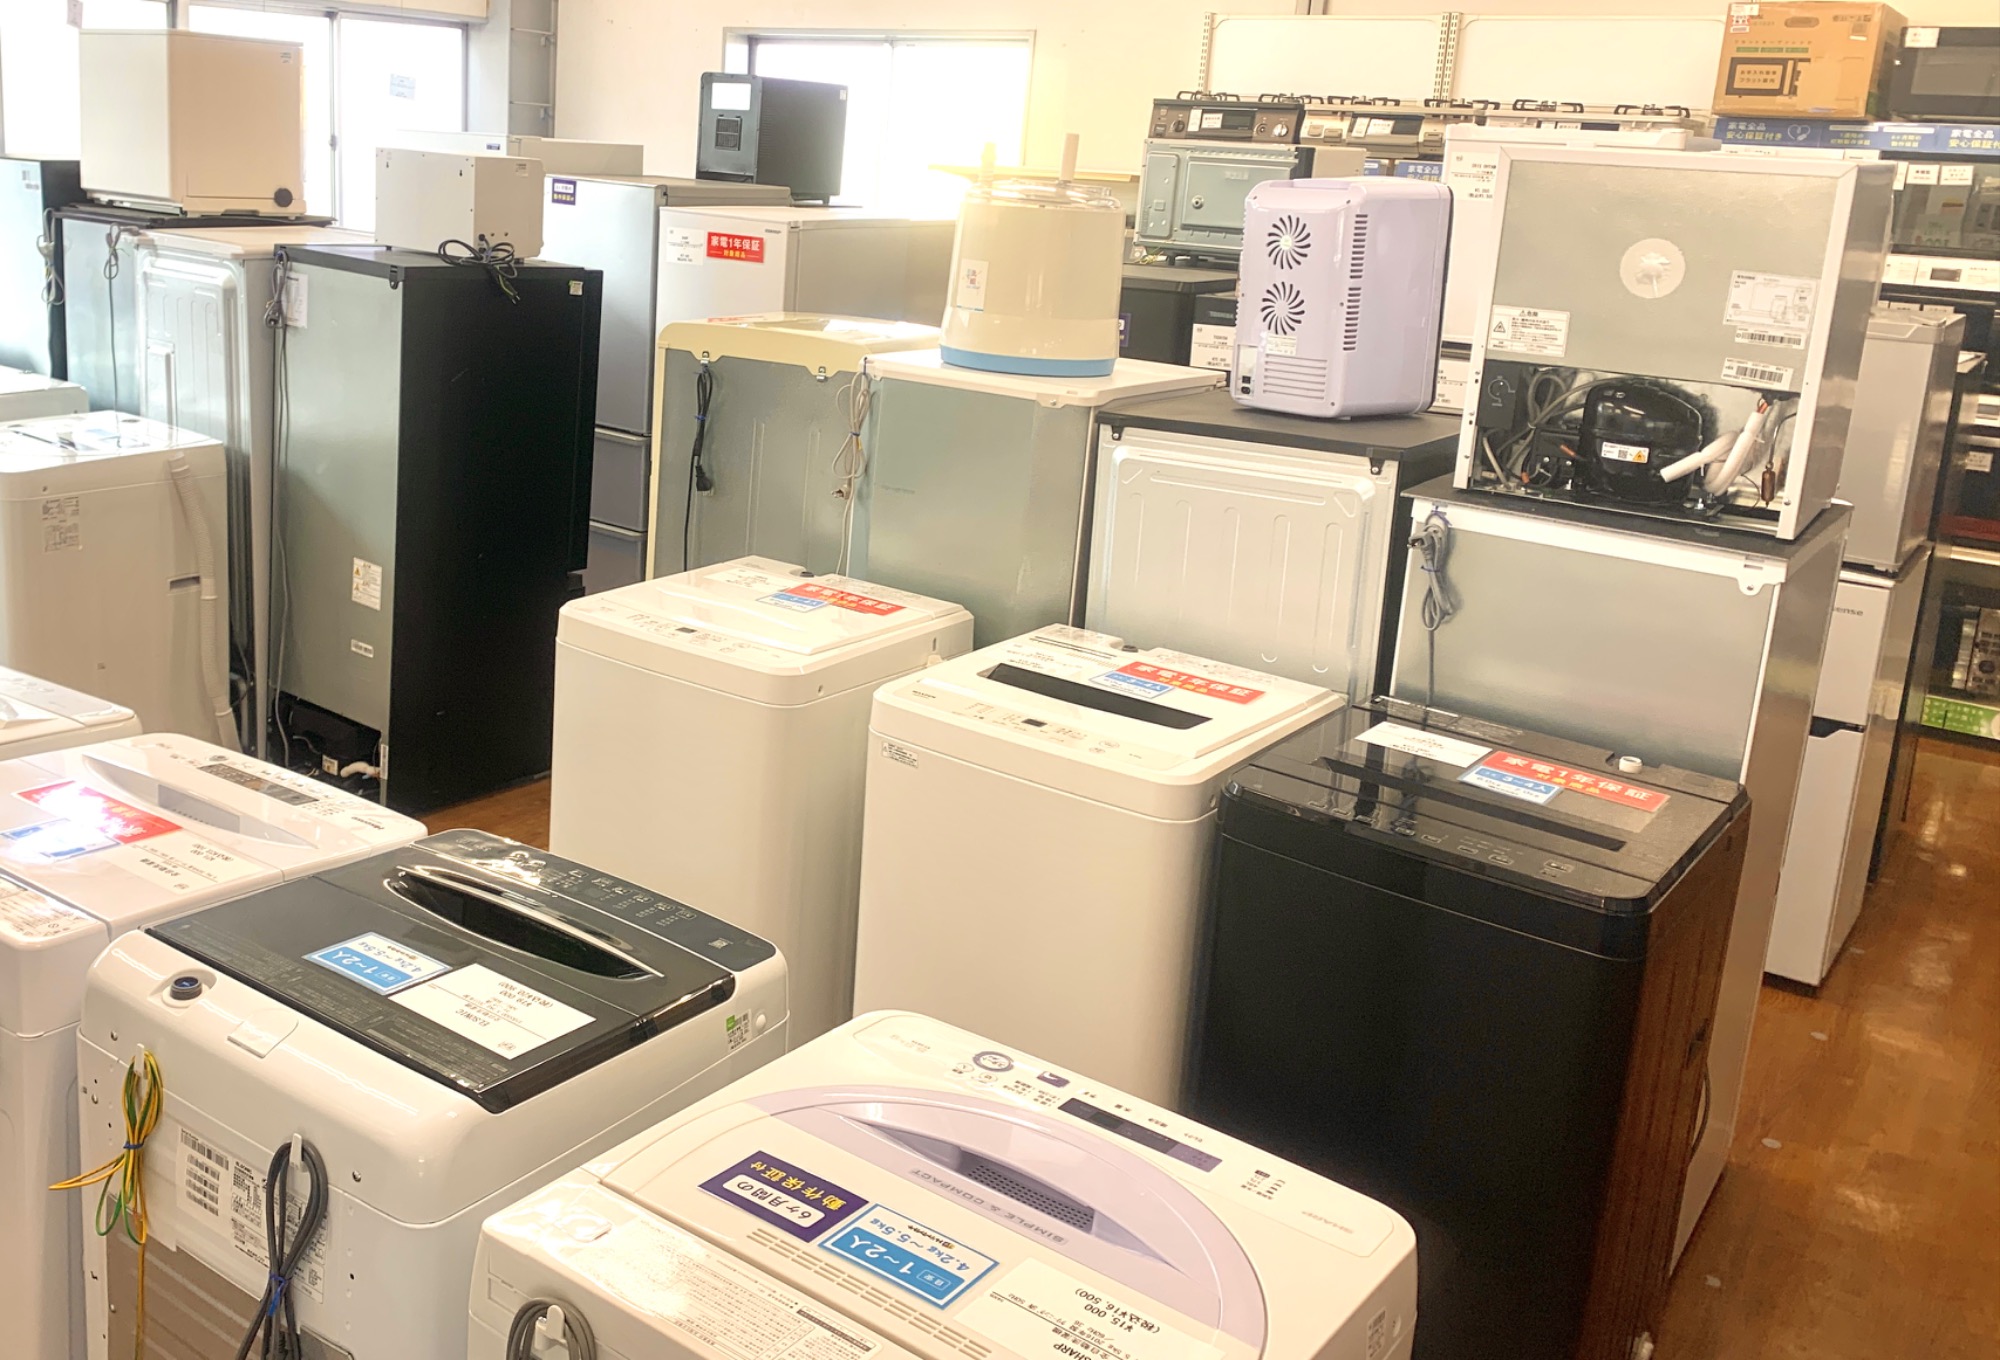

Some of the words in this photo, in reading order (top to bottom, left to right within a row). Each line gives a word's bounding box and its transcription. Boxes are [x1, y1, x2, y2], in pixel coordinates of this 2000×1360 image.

[1726, 131, 1782, 140] 安心保証付き
[1727, 122, 1766, 130] 家電全品
[1950, 130, 1994, 139] 家電全品
[1408, 165, 1440, 174] 家電全品
[710, 236, 760, 251] 家電1年保証
[1834, 608, 1864, 616] ense
[1136, 664, 1254, 697] 家電1年保証
[1502, 756, 1652, 800] 家電1年保証
[327, 950, 381, 974] 1～2人
[737, 1180, 812, 1221] 6ヶ月間の
[750, 1160, 847, 1211] 動作保証付
[911, 1168, 985, 1205] COMPACT
[990, 1205, 1001, 1213] &
[1005, 1211, 1066, 1243] SIMPLE
[849, 1234, 915, 1276] 1～2人
[869, 1218, 971, 1273] 4.2kg～5.5kg
[1074, 1288, 1162, 1334] (税込¥16,500)
[1084, 1303, 1134, 1332] ¥15,000
[1052, 1326, 1110, 1360] 全自動洗濯機
